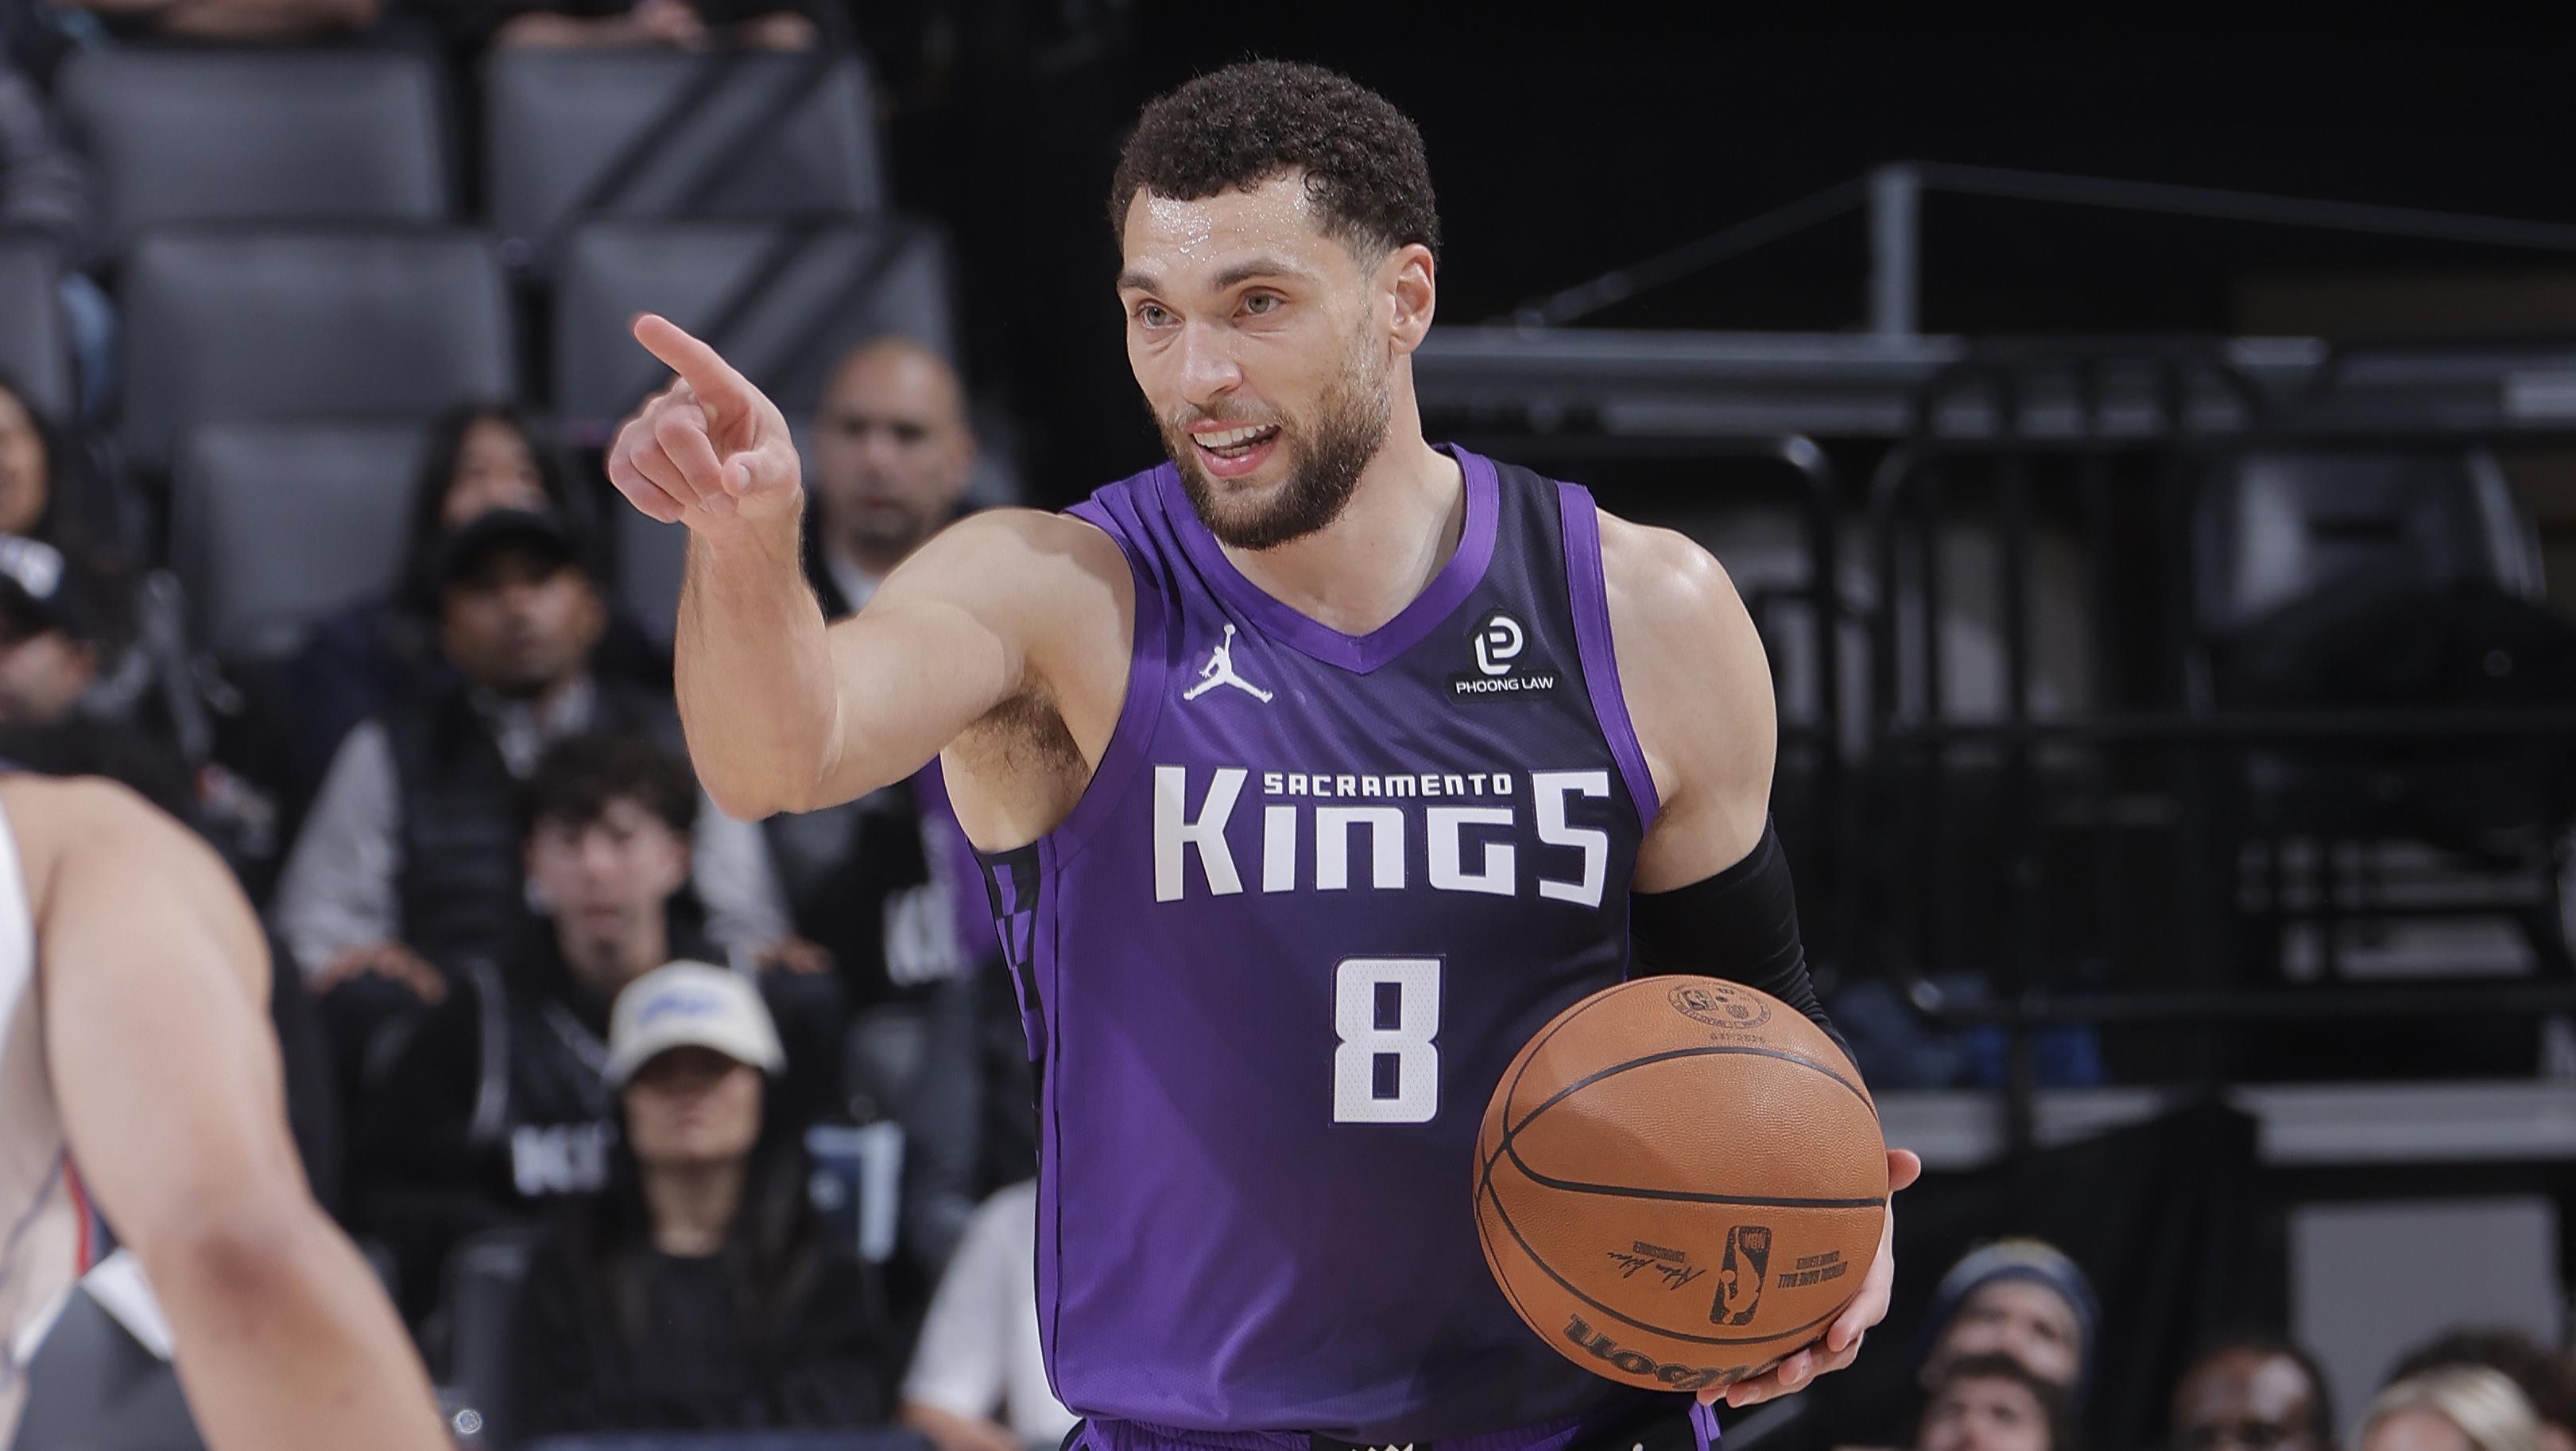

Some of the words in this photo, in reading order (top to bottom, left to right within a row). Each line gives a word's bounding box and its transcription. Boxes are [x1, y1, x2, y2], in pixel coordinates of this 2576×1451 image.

[1455, 678, 1519, 694] PHOONG
[1521, 677, 1553, 689] LAW
[1264, 772, 1513, 797] SACRAMENTO
[1334, 959, 1440, 1123] 8
